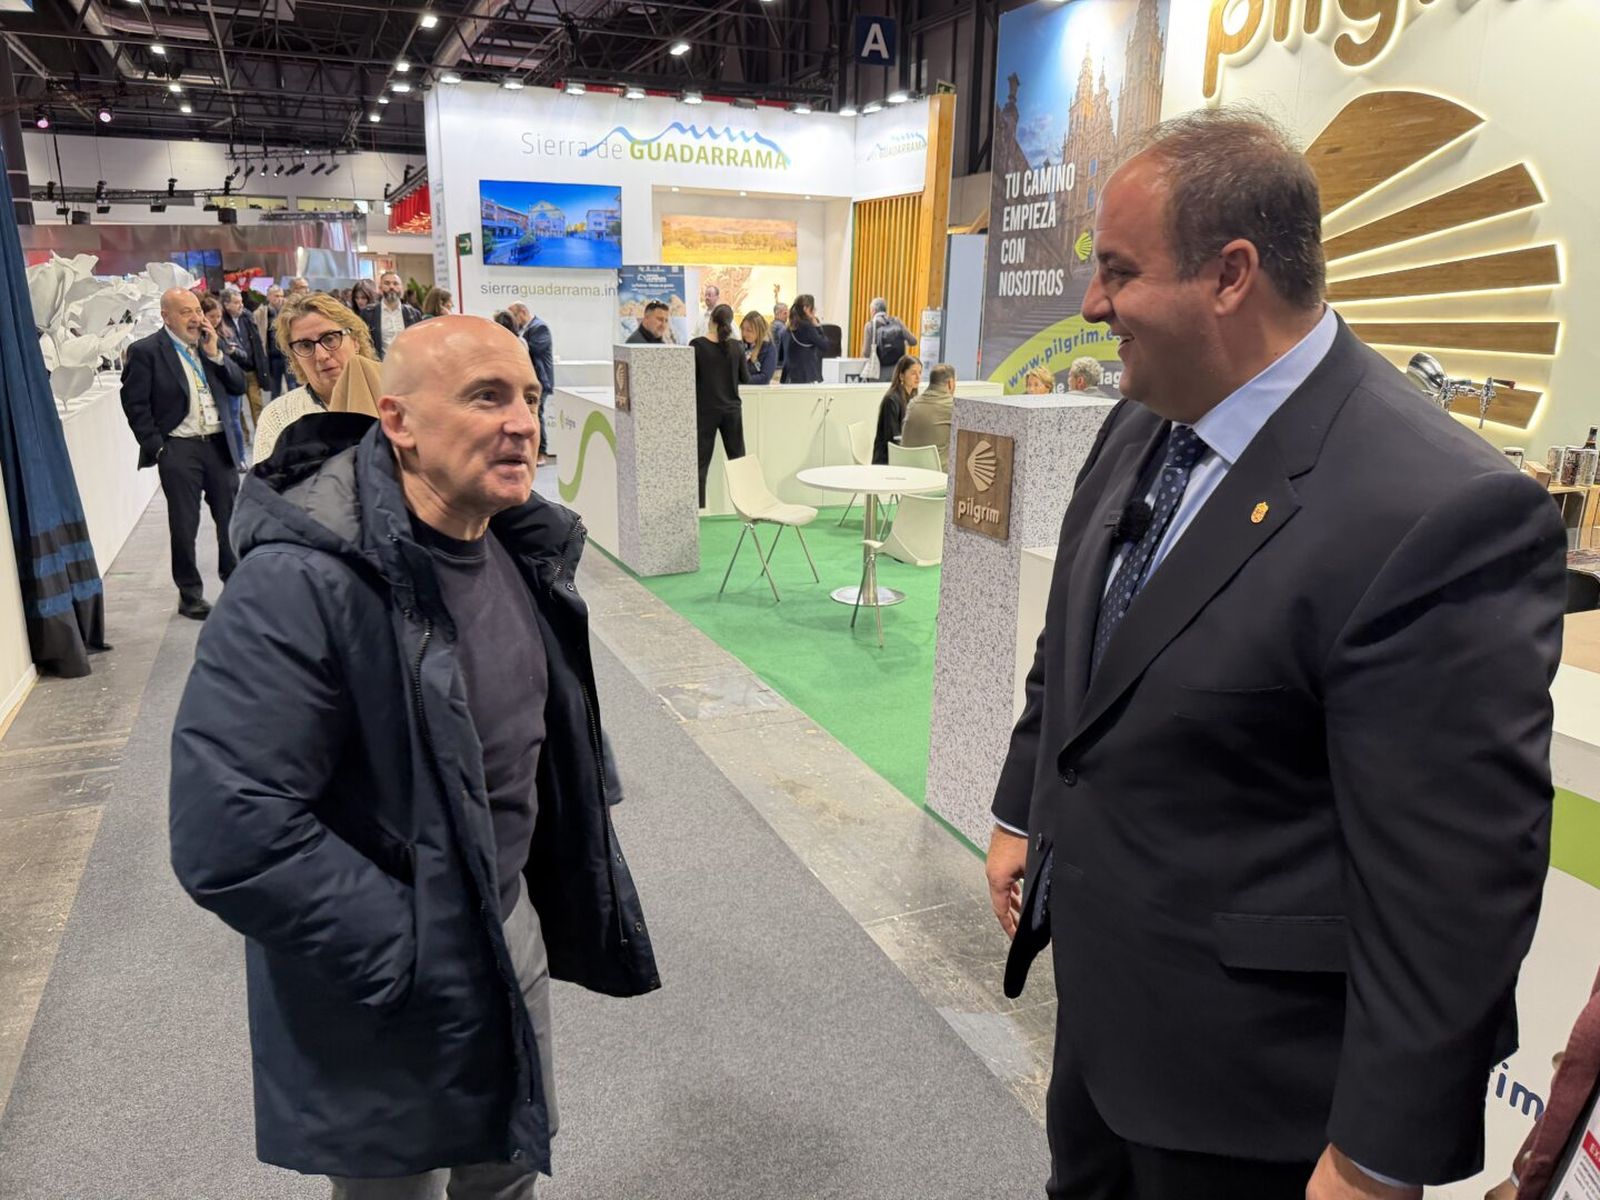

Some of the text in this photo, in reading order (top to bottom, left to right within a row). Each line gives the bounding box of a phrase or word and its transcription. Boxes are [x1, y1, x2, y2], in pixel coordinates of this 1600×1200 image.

[861, 22, 889, 59] A
[521, 131, 788, 170] Sierra de GUADARRAMA
[1005, 162, 1076, 199] TU CAMINO
[1002, 200, 1056, 232] EMPIEZA
[1001, 238, 1026, 265] CON
[480, 281, 619, 298] sierraguadarrama.in
[998, 268, 1064, 296] NOSOTROS
[1008, 328, 1120, 388] www.pilgrim.e
[957, 497, 1000, 524] pilgrim
[1489, 1062, 1544, 1122] im
